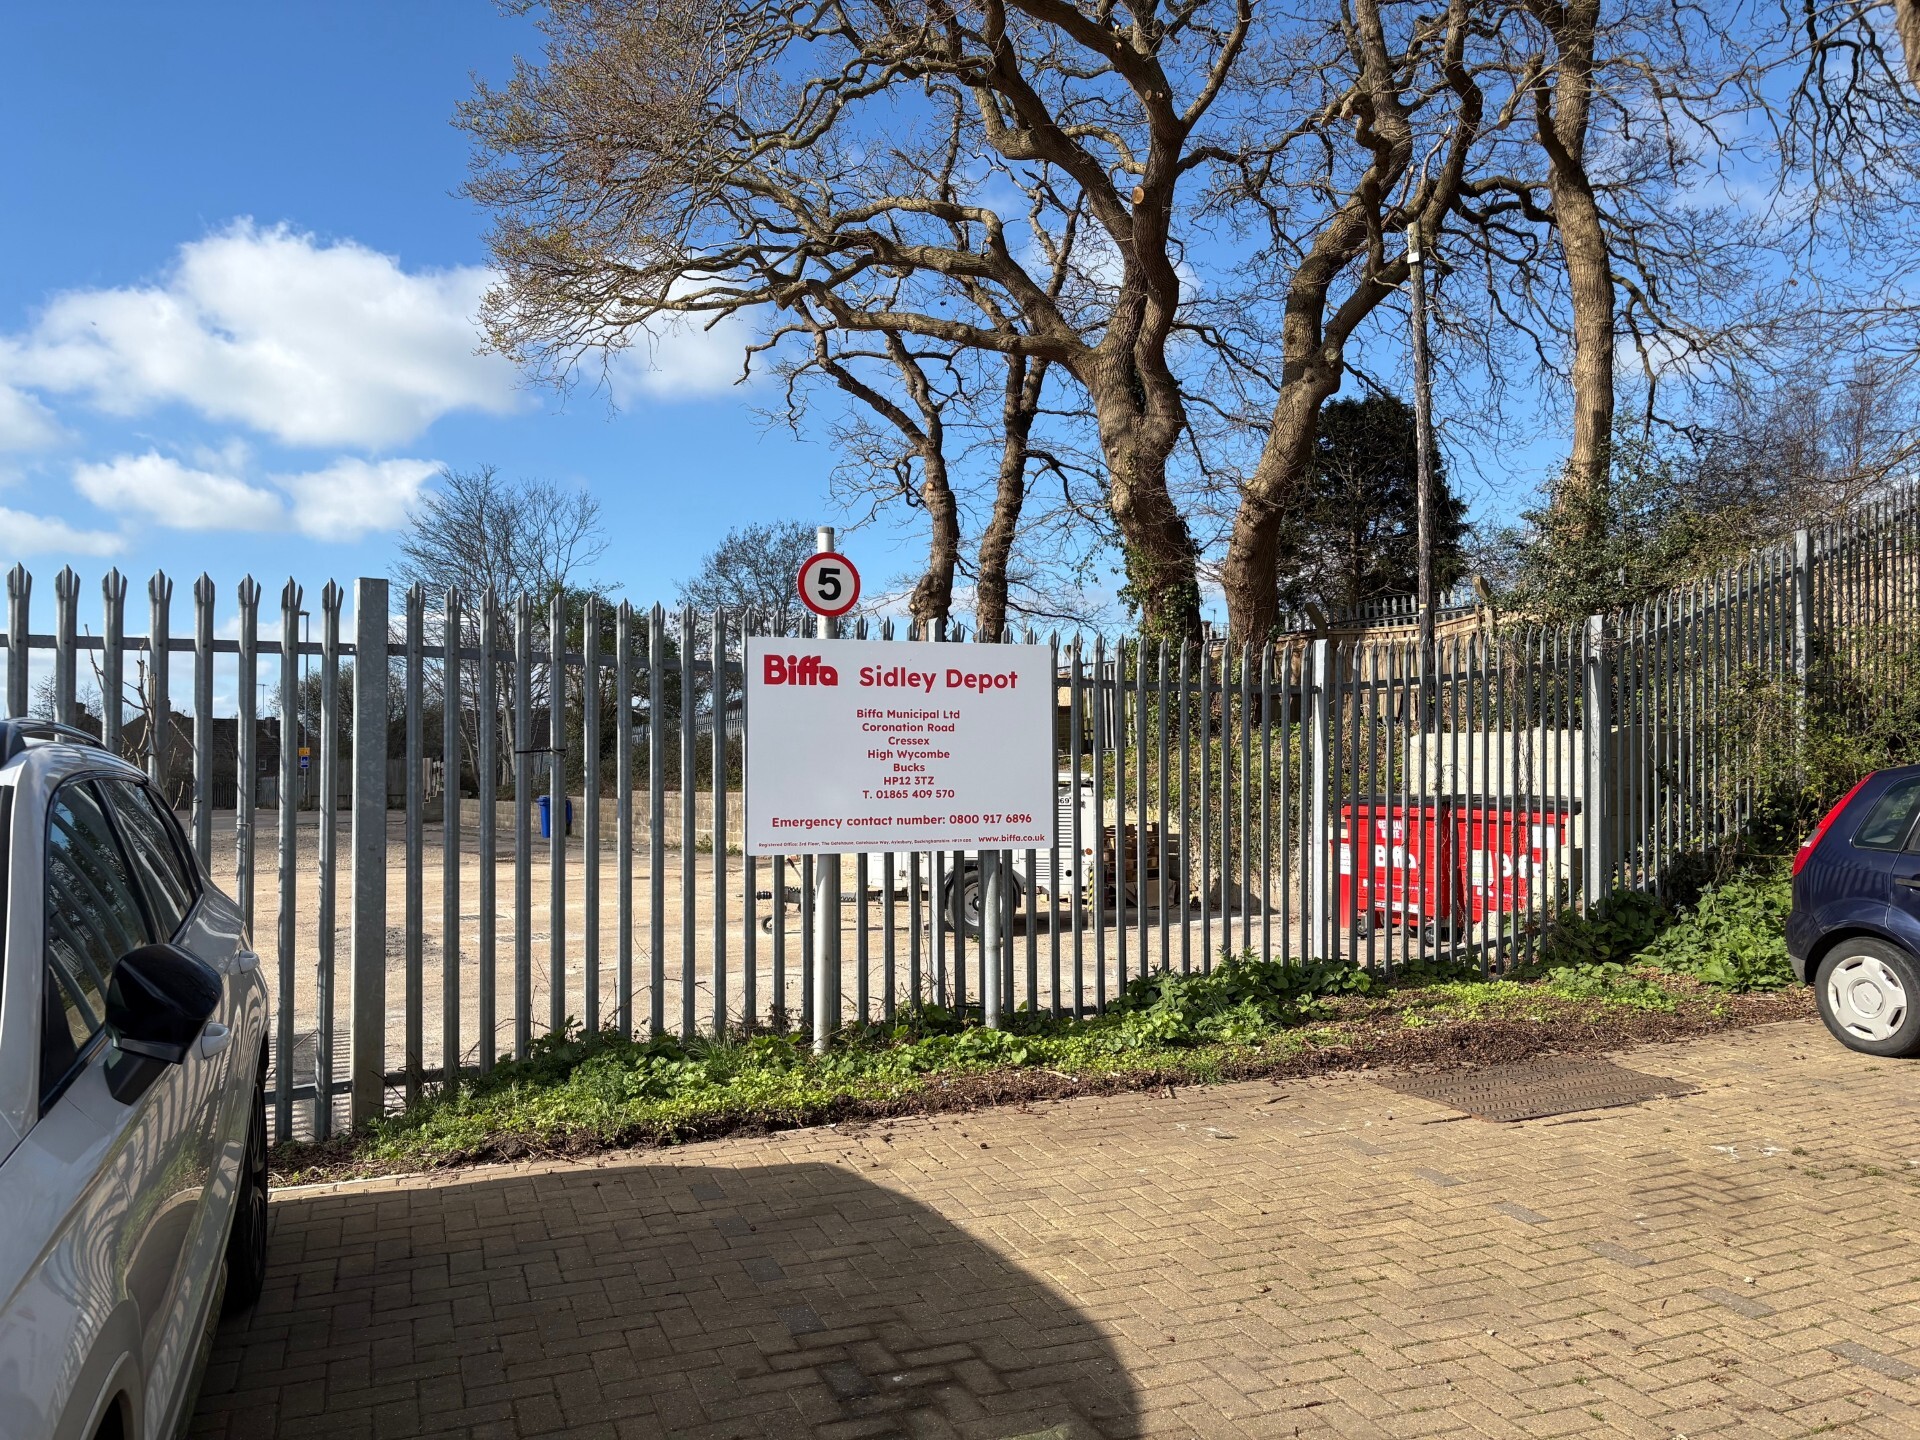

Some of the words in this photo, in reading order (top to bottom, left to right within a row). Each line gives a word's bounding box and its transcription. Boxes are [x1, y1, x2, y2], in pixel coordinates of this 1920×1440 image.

[818, 567, 842, 601] 5
[764, 654, 838, 686] Biffa
[859, 665, 937, 693] Sidley
[946, 669, 1018, 694] Depot
[856, 708, 883, 719] Biffa
[887, 709, 939, 721] Municipal
[943, 709, 960, 719] Ltd
[862, 722, 923, 732] Coronation
[927, 723, 955, 732] Road
[888, 736, 930, 746] Cressex
[867, 749, 893, 761] High
[897, 749, 950, 761] Wycombe
[893, 762, 926, 772] Bucks
[883, 776, 911, 785] HP12
[914, 776, 935, 785] 3TZ
[862, 789, 873, 799] T.
[876, 789, 908, 799] 01865
[912, 789, 933, 799] 409
[935, 789, 955, 799] 570
[772, 817, 842, 830] Emergency
[847, 816, 893, 826] contact
[897, 814, 946, 825] number:
[949, 814, 980, 824] 0800
[983, 814, 1003, 823] 917
[1006, 813, 1032, 823] 6896
[1377, 819, 1403, 830] GERAL
[978, 833, 1045, 843] www.biffa.co.uk
[1380, 829, 1401, 839] WTE
